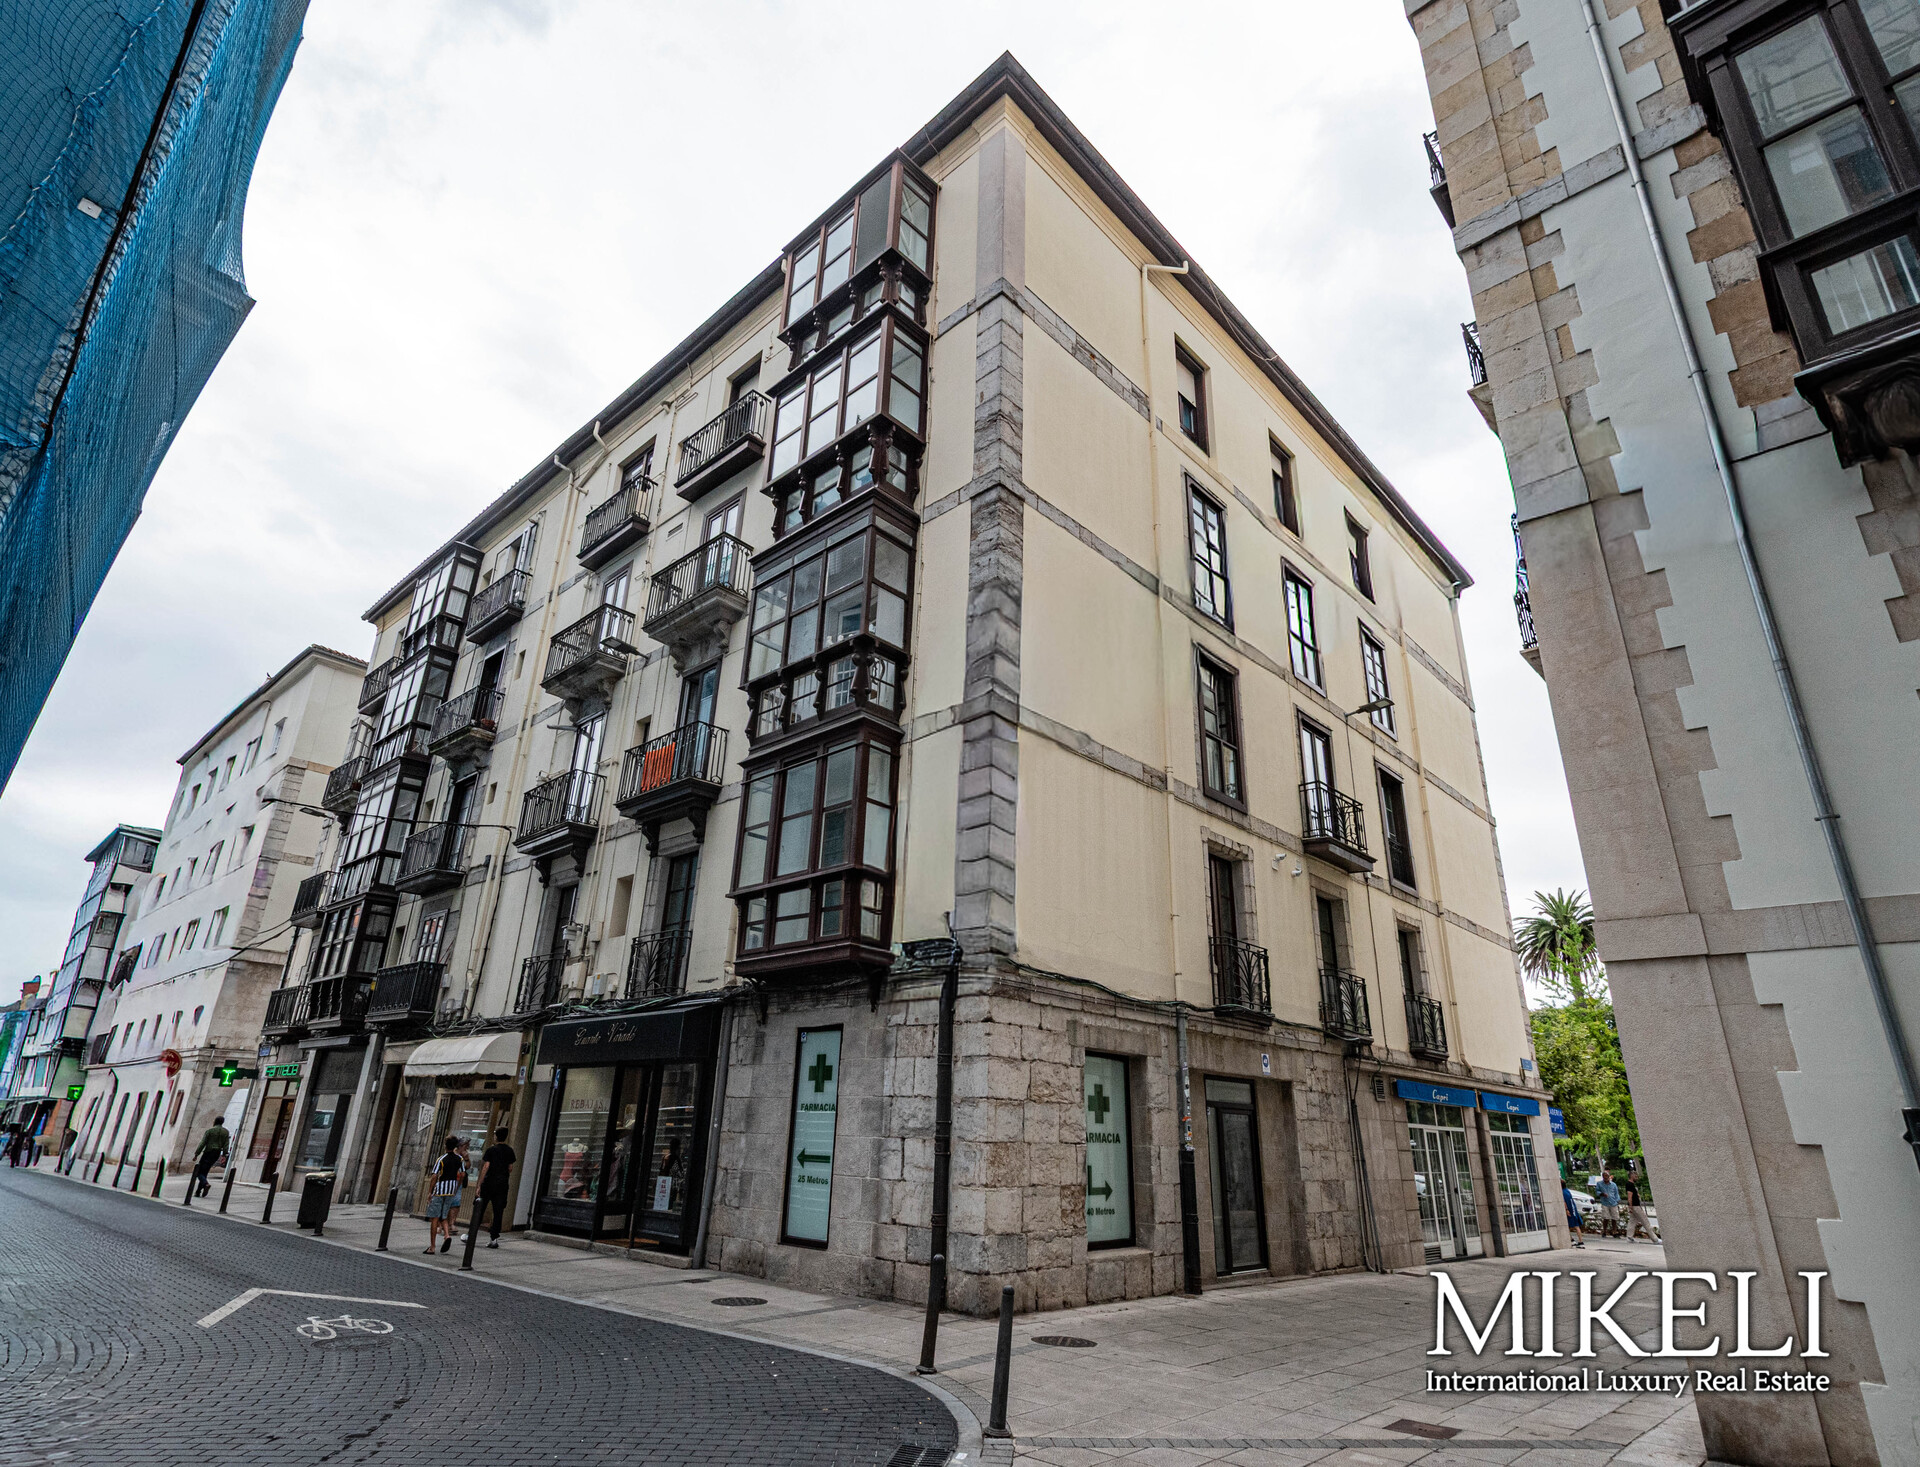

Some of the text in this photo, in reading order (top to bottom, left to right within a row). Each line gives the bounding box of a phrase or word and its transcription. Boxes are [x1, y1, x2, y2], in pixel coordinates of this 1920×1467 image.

[1432, 1089, 1448, 1103] Capri
[800, 1103, 836, 1112] FARMACIA
[1506, 1100, 1520, 1112] Capri
[1086, 1132, 1121, 1144] ARMACIA
[797, 1174, 829, 1185] 25 Metros
[1096, 1207, 1116, 1216] Metros
